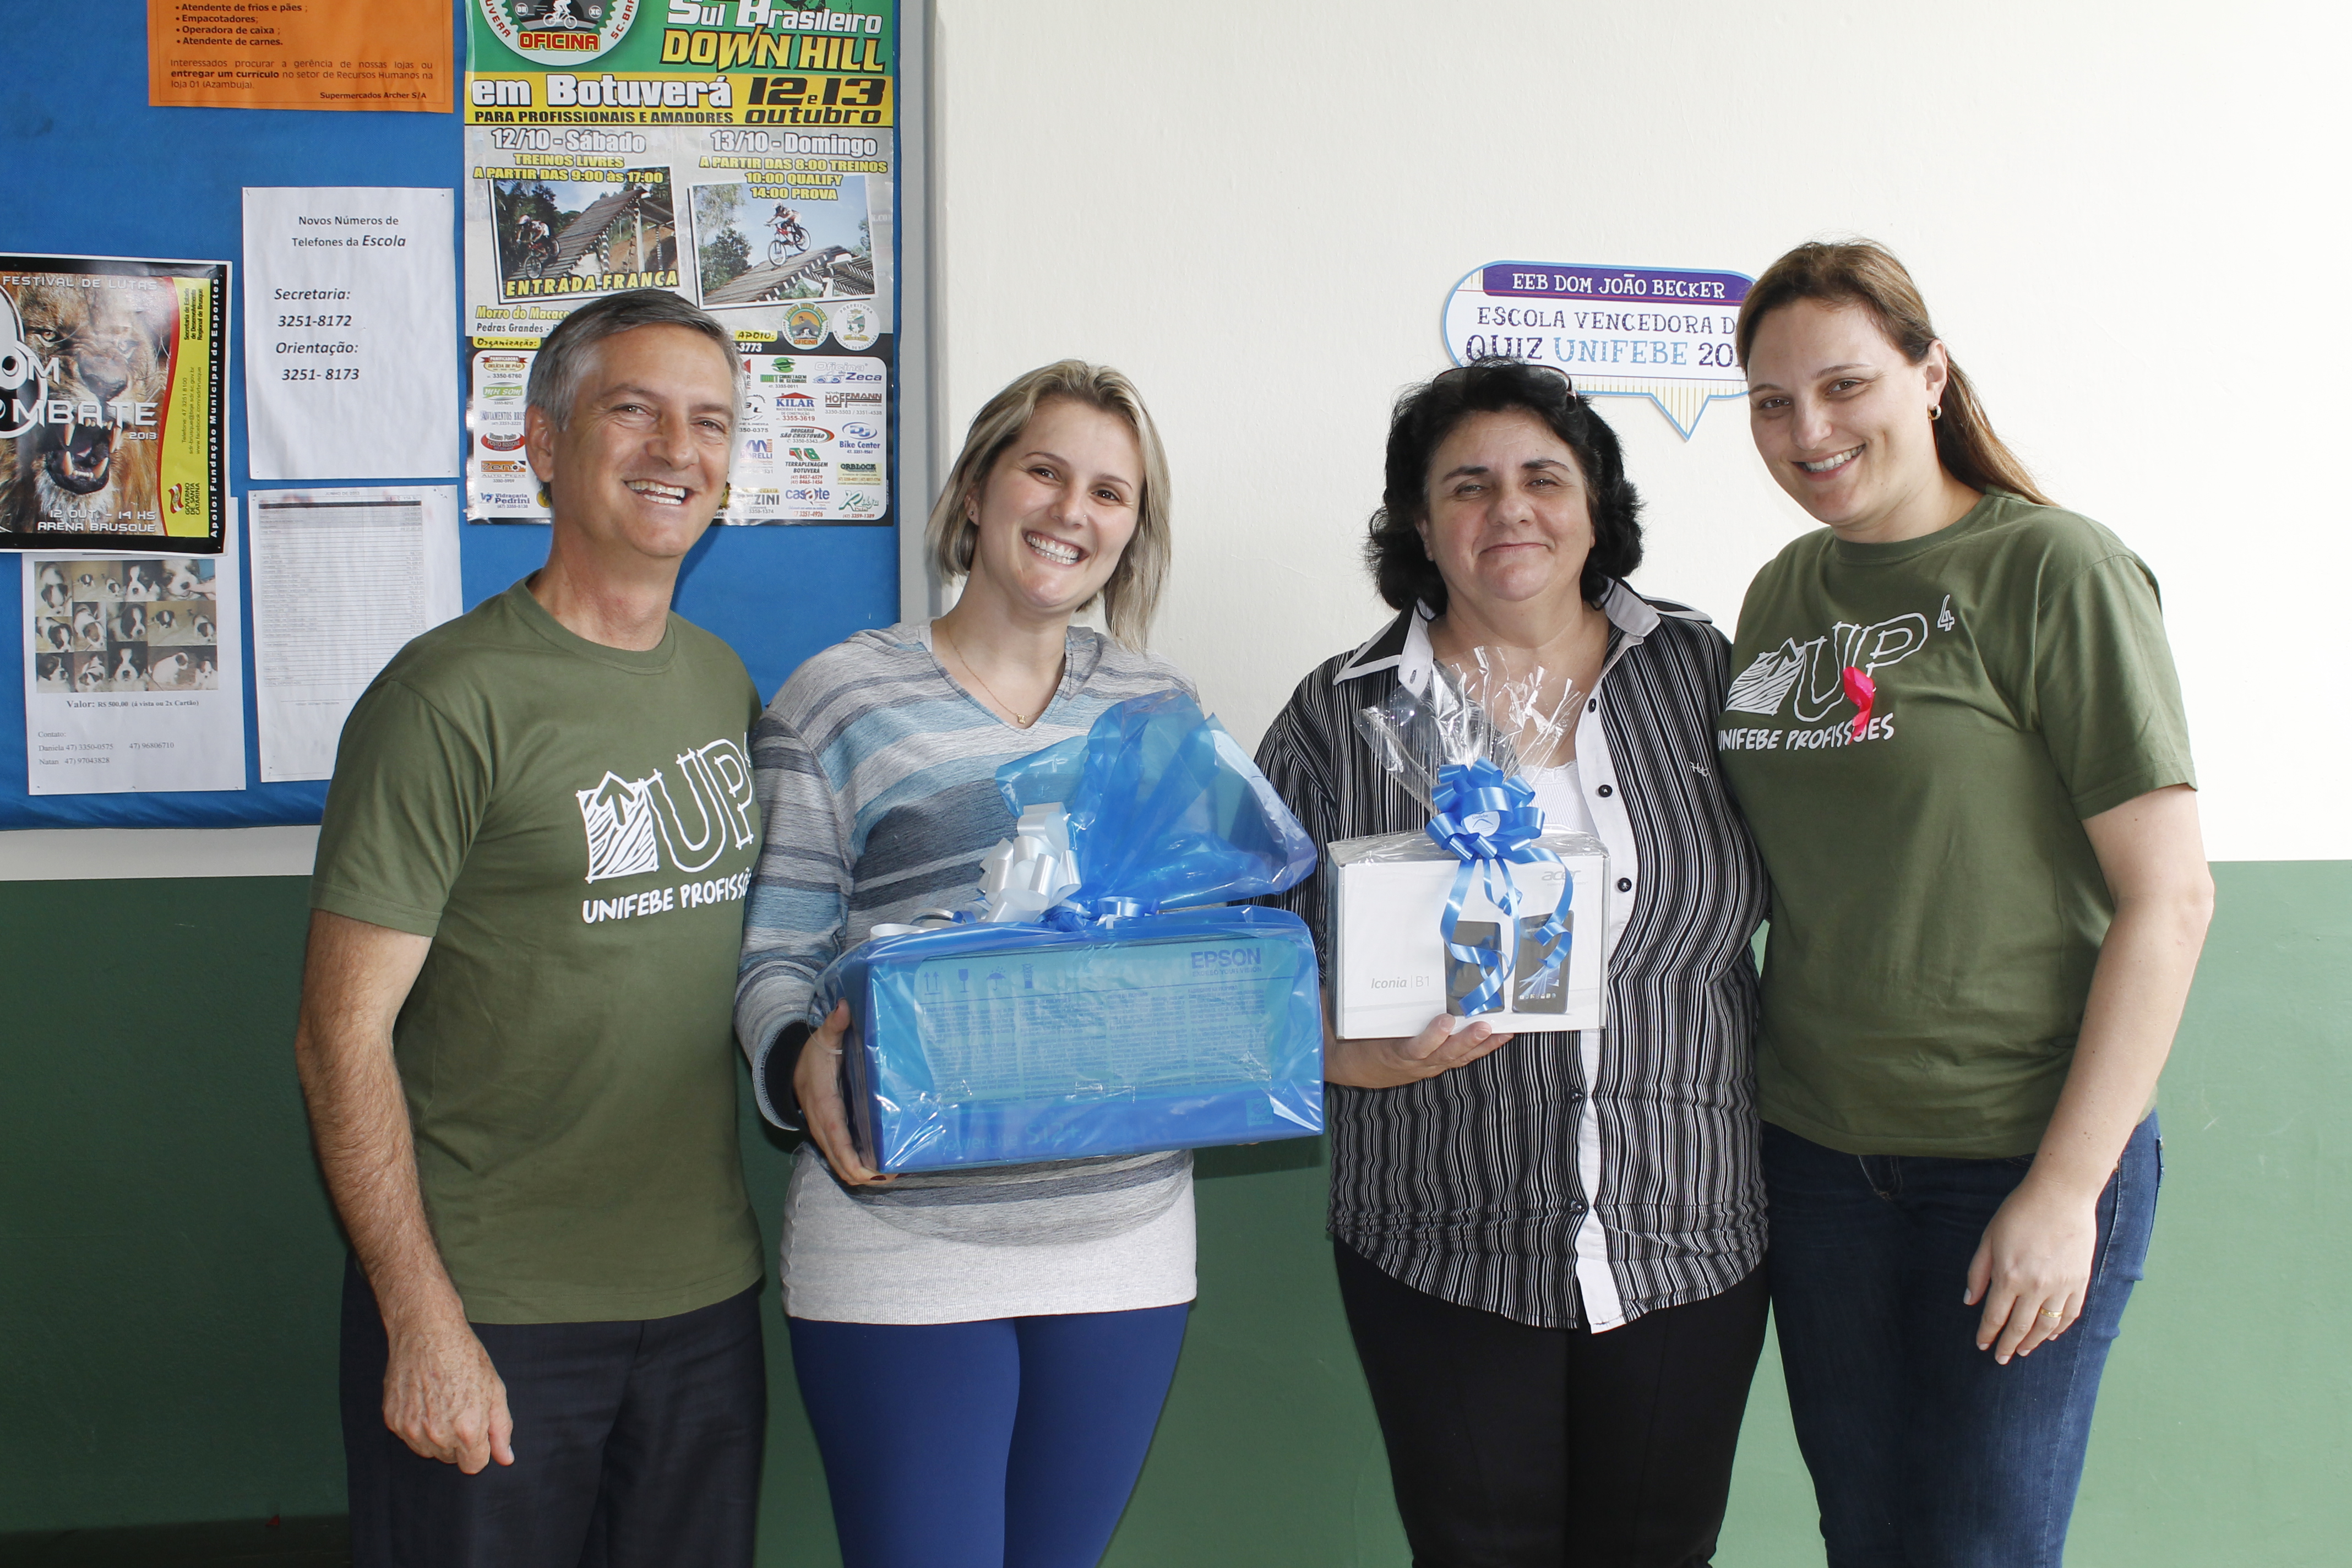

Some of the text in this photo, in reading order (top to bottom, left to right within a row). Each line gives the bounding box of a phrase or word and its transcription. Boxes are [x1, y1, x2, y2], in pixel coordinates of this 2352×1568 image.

[280, 3, 302, 13] pães
[182, 14, 259, 24] Empacotadores;
[667, 0, 883, 33] Sul Brasileiro
[182, 25, 233, 34] Operadora
[183, 36, 232, 45] Atendente
[519, 32, 599, 51] OFICINA
[659, 24, 886, 74] DOWN HILL
[171, 59, 227, 67] Interessados
[294, 59, 333, 68] gerência
[395, 61, 414, 69] lojas
[171, 70, 215, 78] entregar
[171, 80, 187, 89] loja
[203, 80, 254, 89] (Azambuja).
[471, 74, 886, 108] em Botuverá 12 e 13
[320, 92, 381, 100] Supermercados
[475, 107, 882, 124] PARA PROFISSIONAIS E AMADORES outubro
[491, 128, 647, 153] 12/10 Sábado
[710, 129, 878, 157] 13/10 Domingo
[513, 153, 625, 168] TREINOS LIVRES
[699, 156, 888, 173] A PARTIR DAS 8:00 TREINOS
[473, 167, 664, 183] A PARTIR DAS 9:00 às 17:00
[745, 172, 843, 186] 10:00 QUALIFY
[750, 187, 838, 200] 14:00 PROVA
[298, 215, 400, 226] Novos Números de
[292, 235, 406, 248] Telefones da Escola
[2, 276, 158, 291] FESTIVAL DE LUTAS
[505, 270, 678, 297] ENTRADA FRANCA
[1512, 273, 1726, 300] EEB DOM JOÃO BECKER
[274, 287, 351, 301] Secretaria:
[475, 305, 570, 320] Morro do Macaco
[277, 315, 352, 328] 3251-8172
[477, 322, 506, 332] Pedras
[509, 323, 543, 333] Grandes
[1477, 306, 1736, 335] ESCOLA VENCEDORA D
[737, 331, 775, 340] APOIO:
[275, 341, 359, 357] Orientação:
[476, 337, 537, 349] Organização:
[1465, 334, 1741, 368] QUIZ UNIFEBE 20
[281, 368, 360, 381] 3251- 8173
[845, 372, 883, 381] Zeca
[776, 399, 815, 407] KILAR
[824, 392, 882, 408] HOFFMANN
[209, 278, 220, 538] Apoio: Fundação Municipal de Esportes
[128, 431, 157, 440] 2013
[50, 509, 156, 520] 12 14 HS
[37, 521, 156, 532] ARENA BRUSQUE
[1718, 727, 1783, 752] UNIFEBE
[64, 758, 77, 766] 47)
[581, 887, 674, 924] UNIFEBE
[1190, 948, 1262, 969] EPSON
[1371, 975, 1430, 989] Iconia B1
